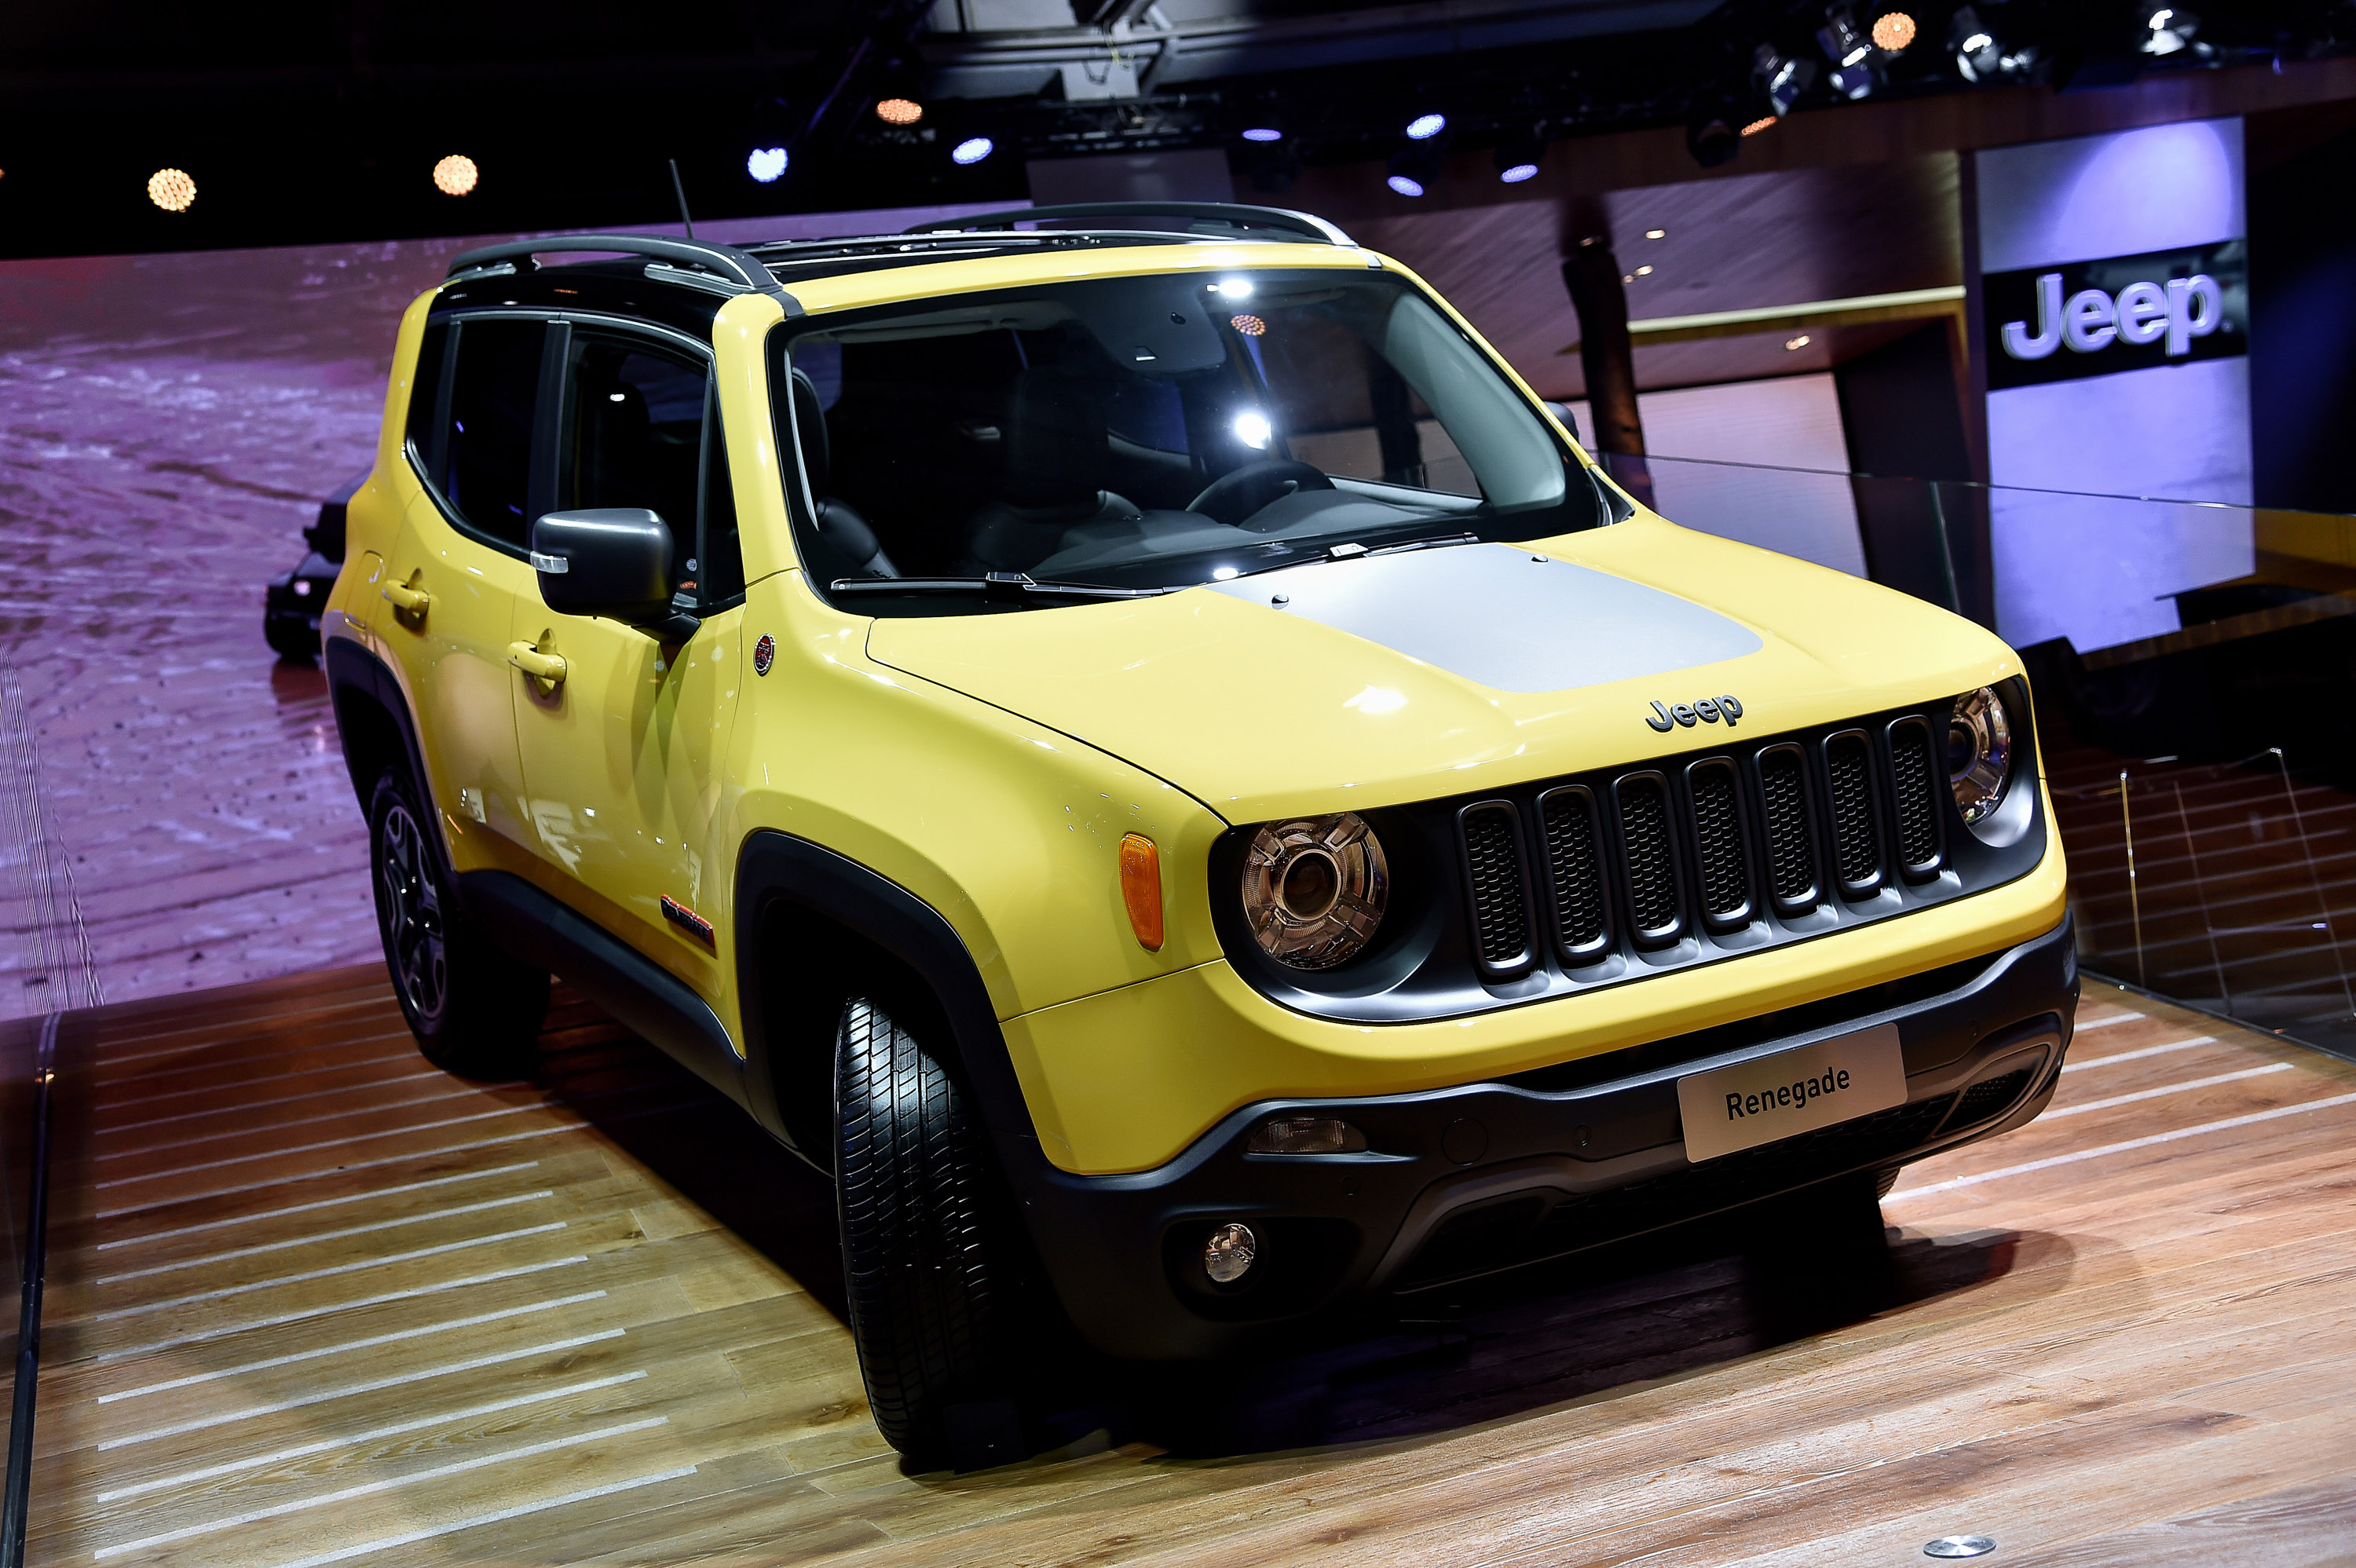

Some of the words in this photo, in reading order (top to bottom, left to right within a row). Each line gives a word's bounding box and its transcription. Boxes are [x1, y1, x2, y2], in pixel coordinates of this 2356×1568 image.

[2001, 273, 2222, 360] Jeep
[1645, 695, 1743, 733] Jeep
[1725, 1066, 1850, 1121] Renegade
